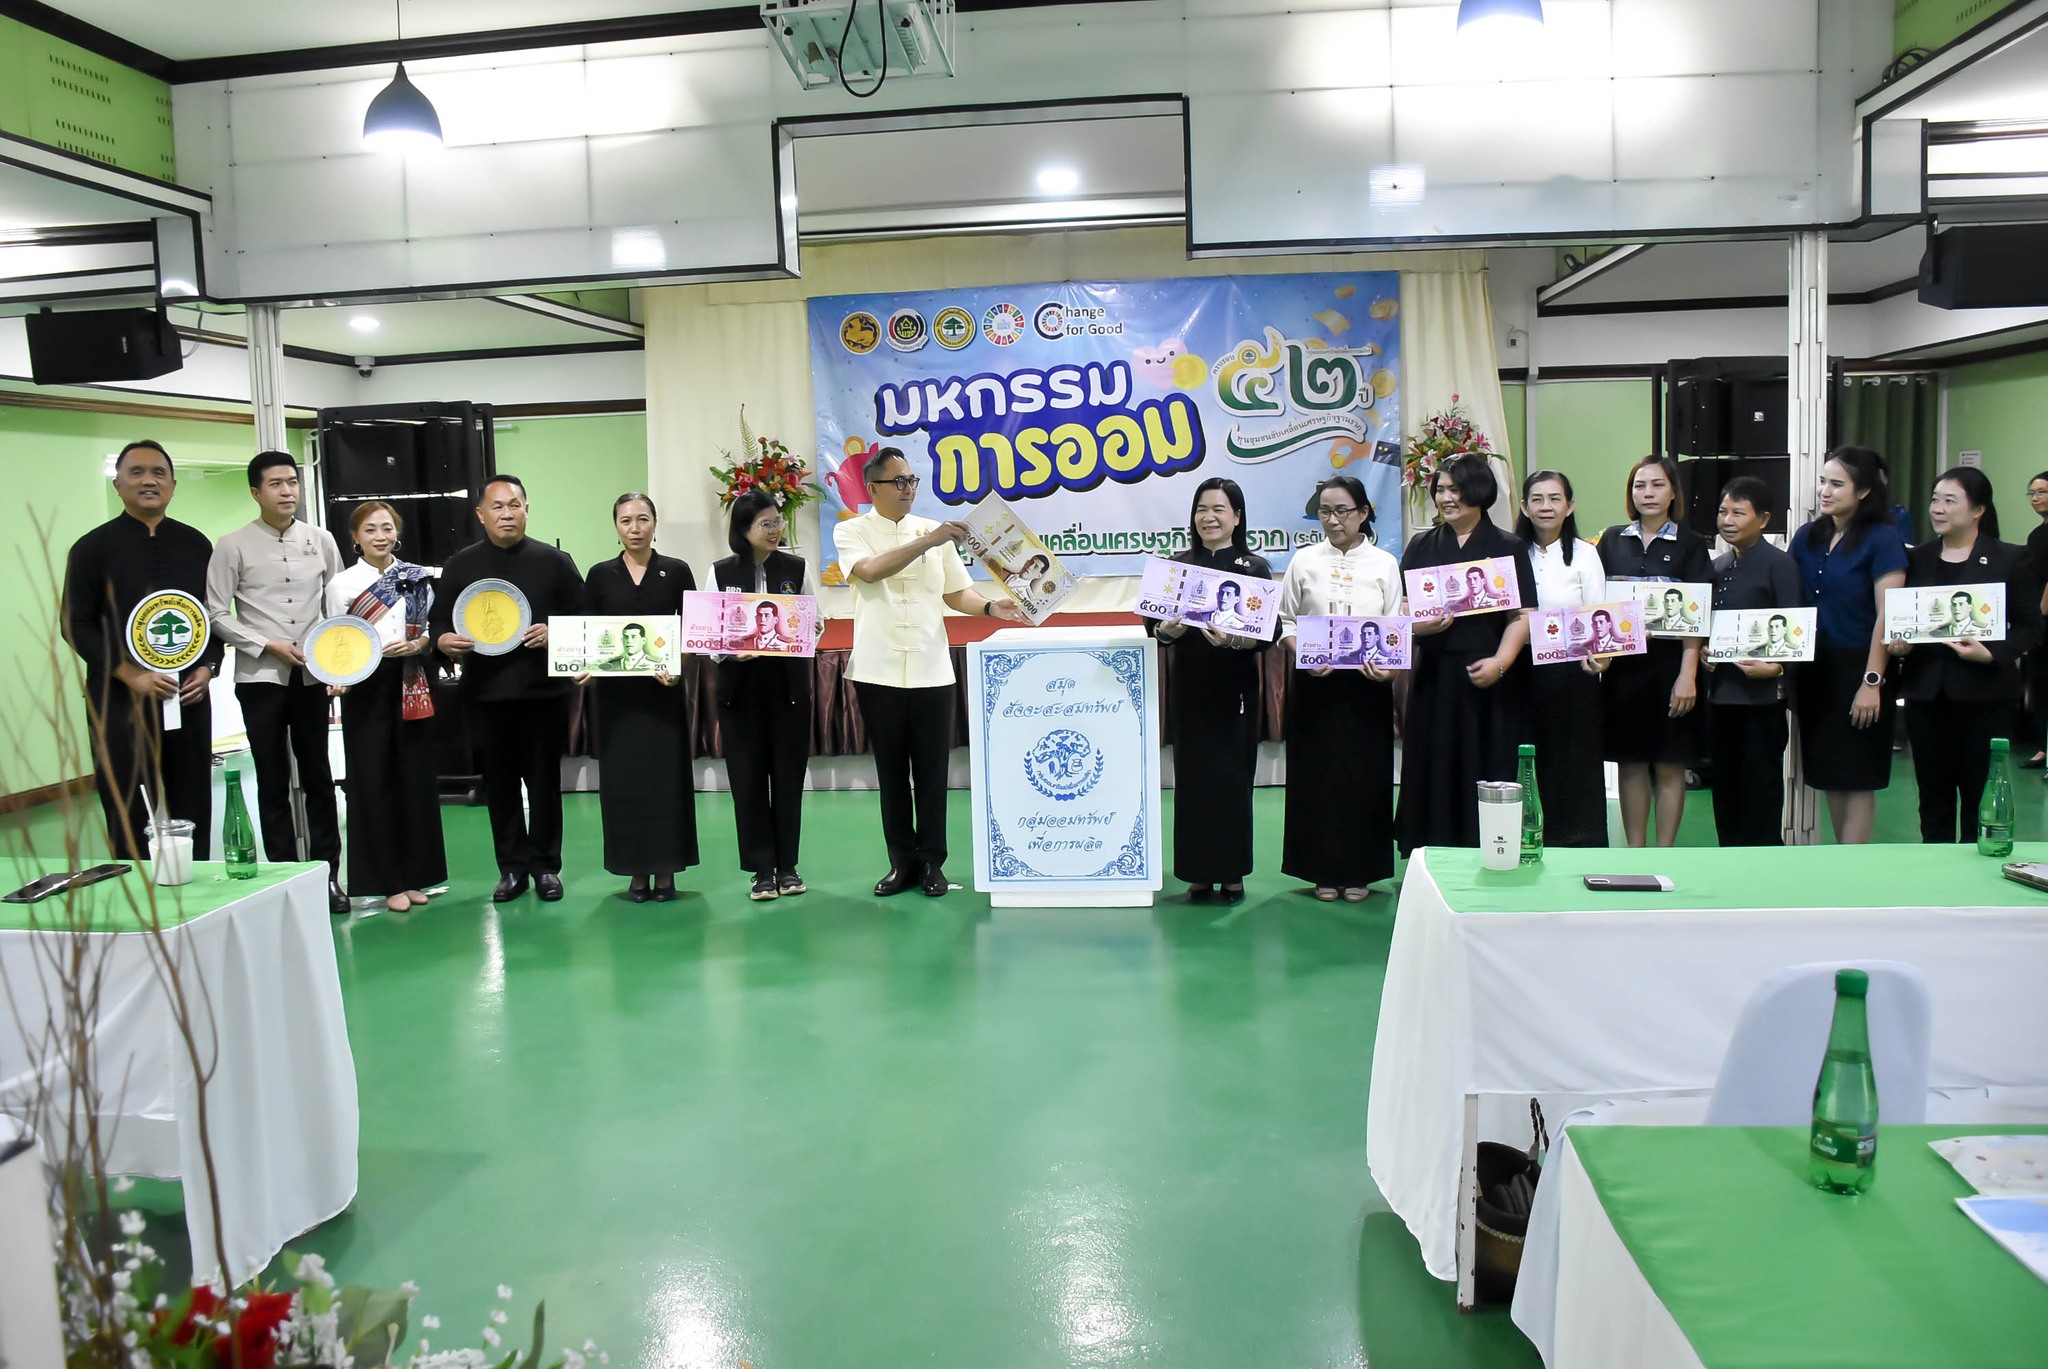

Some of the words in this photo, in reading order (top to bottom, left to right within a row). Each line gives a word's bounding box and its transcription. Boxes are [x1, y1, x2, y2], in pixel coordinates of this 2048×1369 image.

[1066, 324, 1085, 336] for
[1088, 323, 1123, 336] Good
[882, 367, 1127, 426] มหกรรม
[1358, 387, 1369, 403] ปี
[935, 401, 1194, 493] การออม
[1021, 597, 1038, 614] 1000
[1140, 599, 1167, 614] ๕๐๐
[1496, 599, 1510, 607] 100
[1243, 625, 1261, 634] 500
[1980, 629, 1992, 637] 20
[686, 640, 713, 650] ๑๐๐
[786, 645, 803, 653] 100
[1300, 654, 1324, 665] ๕๐๐
[1537, 652, 1559, 660] ๑๐๐
[1713, 649, 1733, 659] ๒๐
[1792, 650, 1803, 658] 20
[554, 661, 580, 673] ๒๐
[655, 663, 667, 672] 20
[1046, 677, 1076, 696] สมุด
[1002, 699, 1124, 717] สัจจะสะสมทรัพย์
[1017, 811, 1116, 831] กลุ่มออมทรัพย์
[1028, 832, 1103, 851] เพื่อการผลิต
